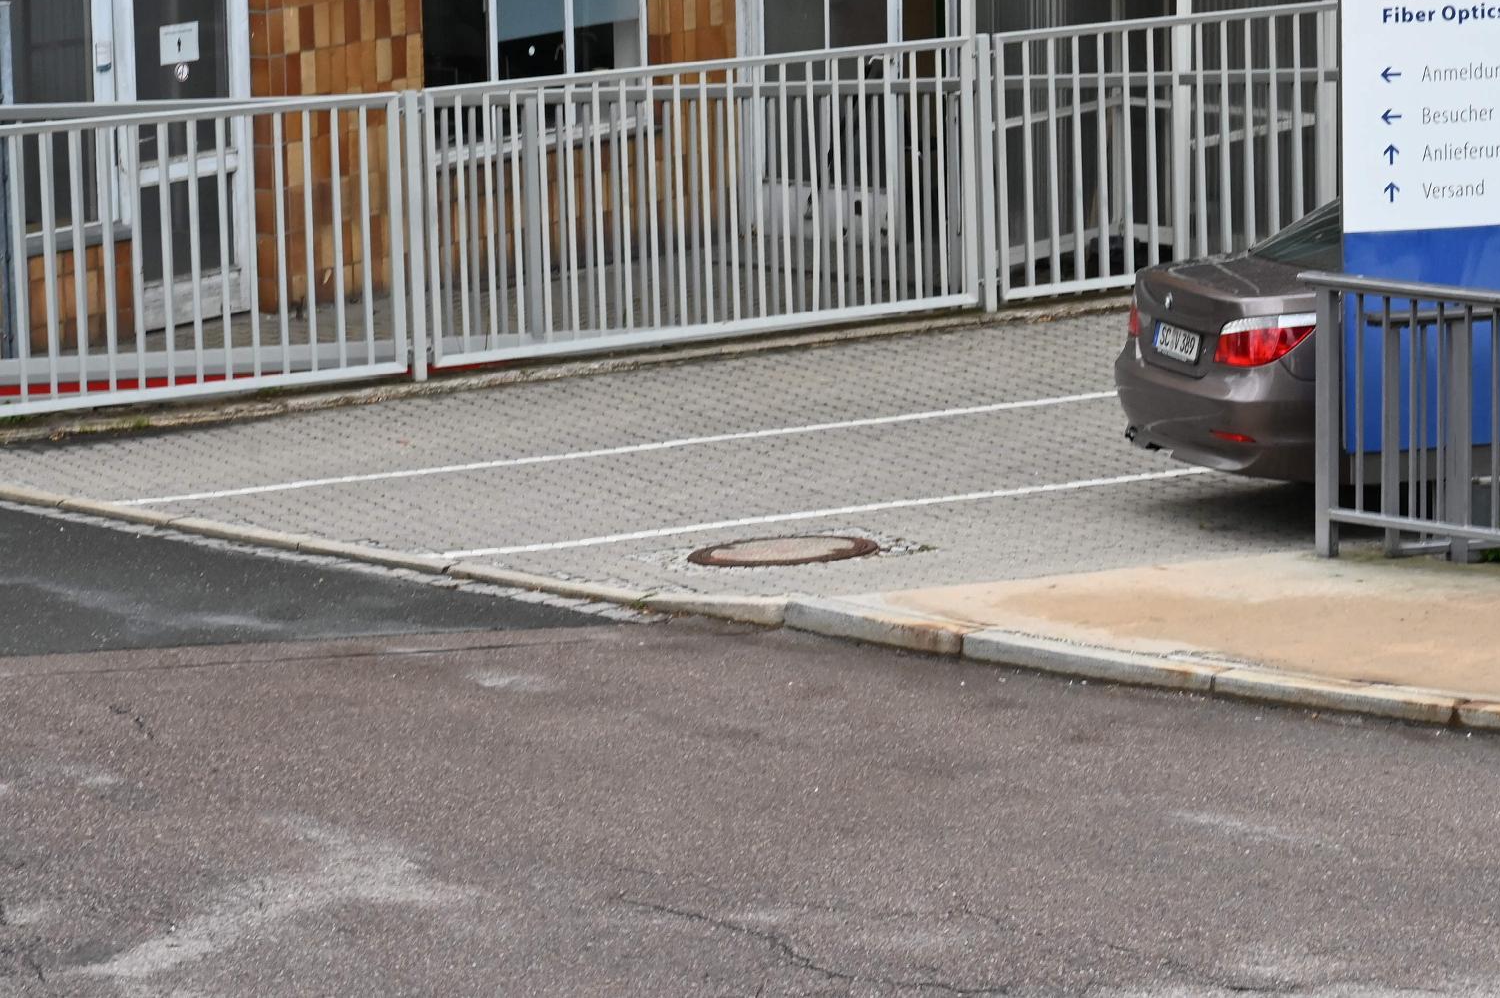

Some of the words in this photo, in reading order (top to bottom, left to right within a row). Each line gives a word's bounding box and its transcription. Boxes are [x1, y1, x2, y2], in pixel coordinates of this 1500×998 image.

[1382, 6, 1436, 23] Fiber
[1422, 105, 1494, 124] Besucher
[1422, 180, 1485, 199] Versand
